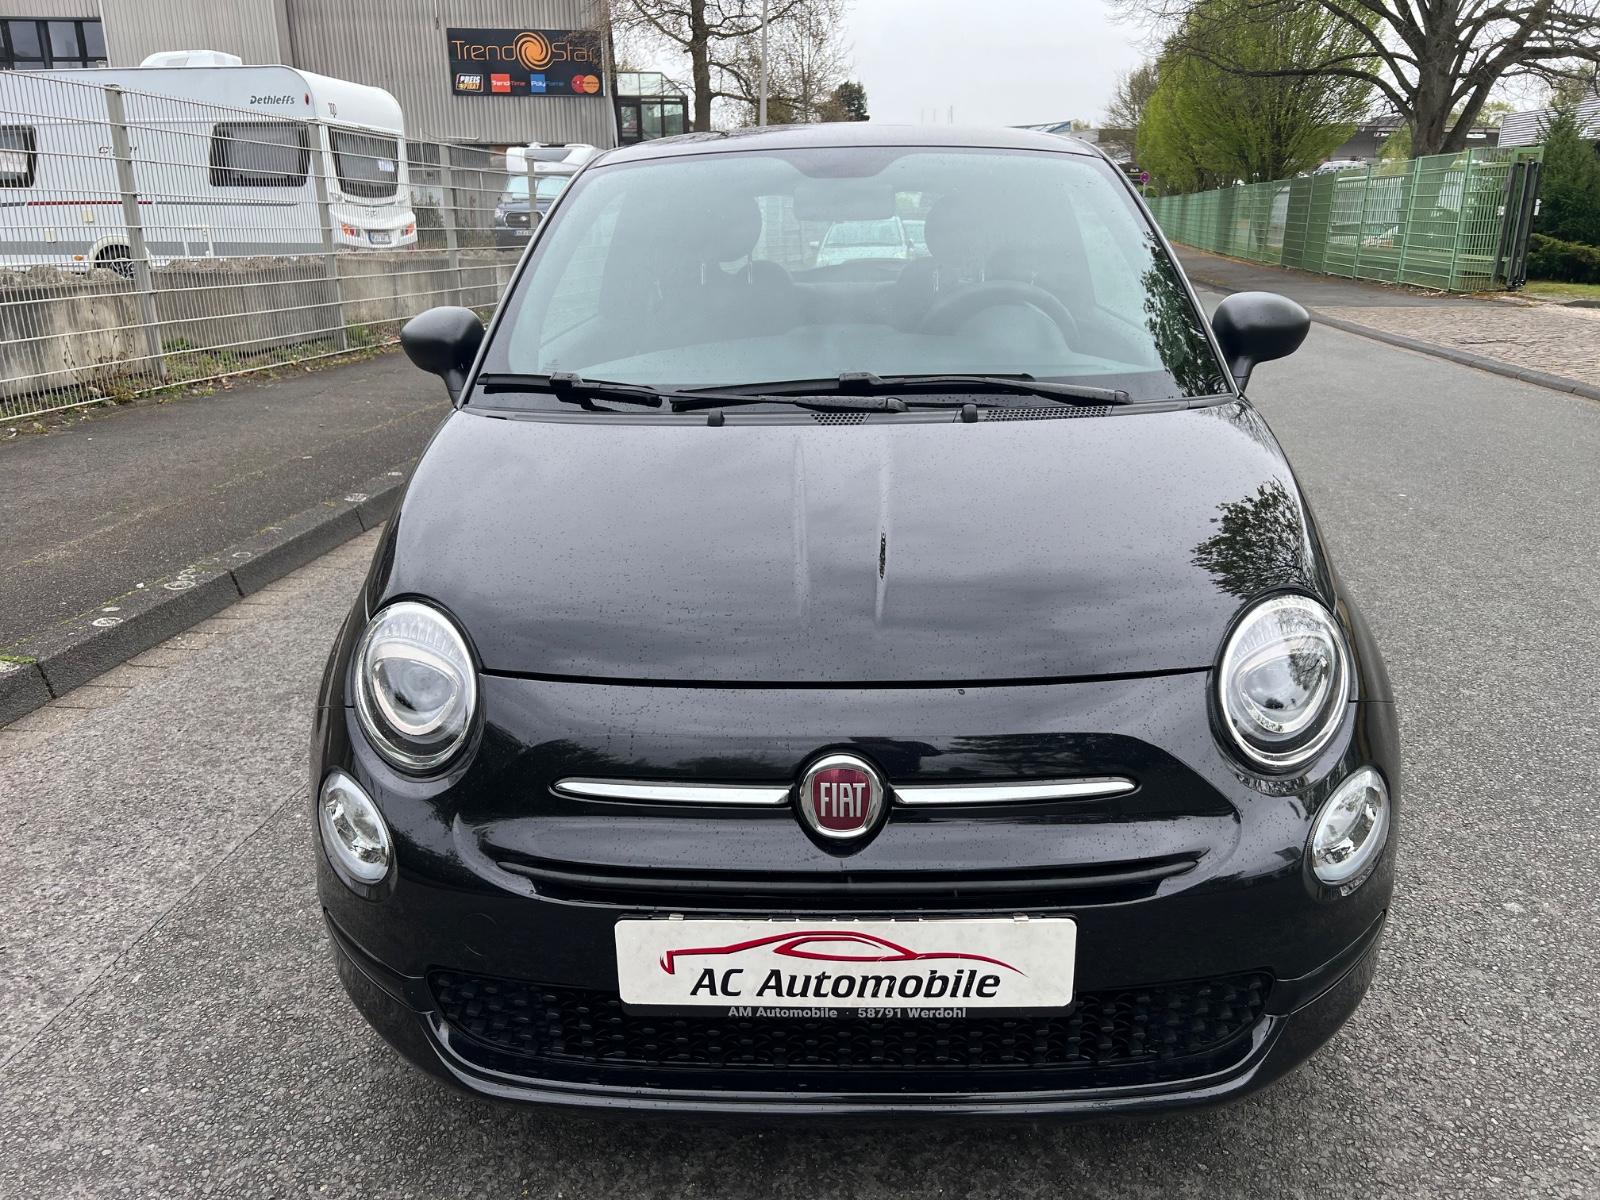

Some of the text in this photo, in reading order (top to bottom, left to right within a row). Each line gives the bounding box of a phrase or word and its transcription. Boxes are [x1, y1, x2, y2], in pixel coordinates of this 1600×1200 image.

[451, 40, 594, 62] Trend Star
[460, 75, 480, 84] PREIS
[250, 95, 295, 105] Dethleffs
[820, 782, 866, 818] FIAT
[690, 967, 1001, 999] AC Automobile
[728, 1006, 967, 1018] AM Automobile 58791 Werdohl
